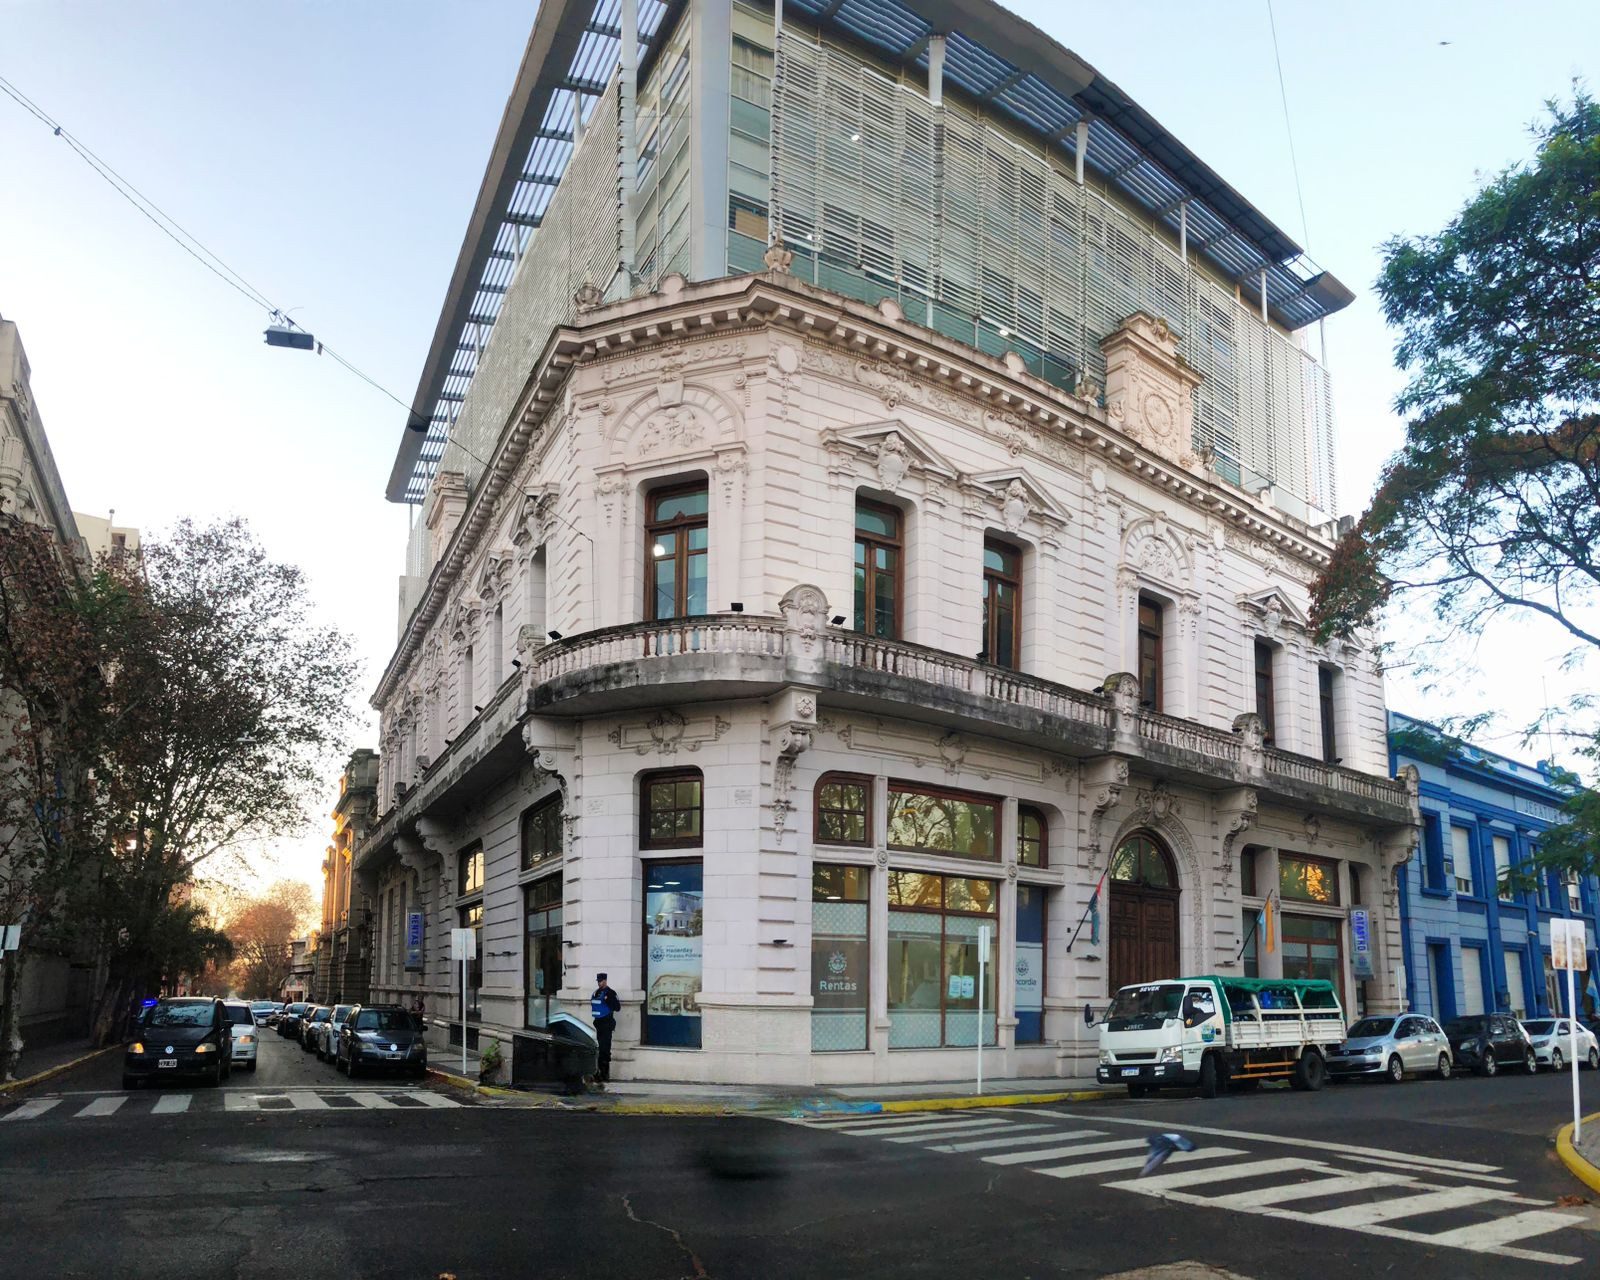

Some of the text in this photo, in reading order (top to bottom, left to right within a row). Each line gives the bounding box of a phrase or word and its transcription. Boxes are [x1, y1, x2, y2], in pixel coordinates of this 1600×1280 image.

[411, 914, 420, 945] RENTAS
[1355, 911, 1367, 951] CATASTRO
[819, 980, 857, 991] Rentas
